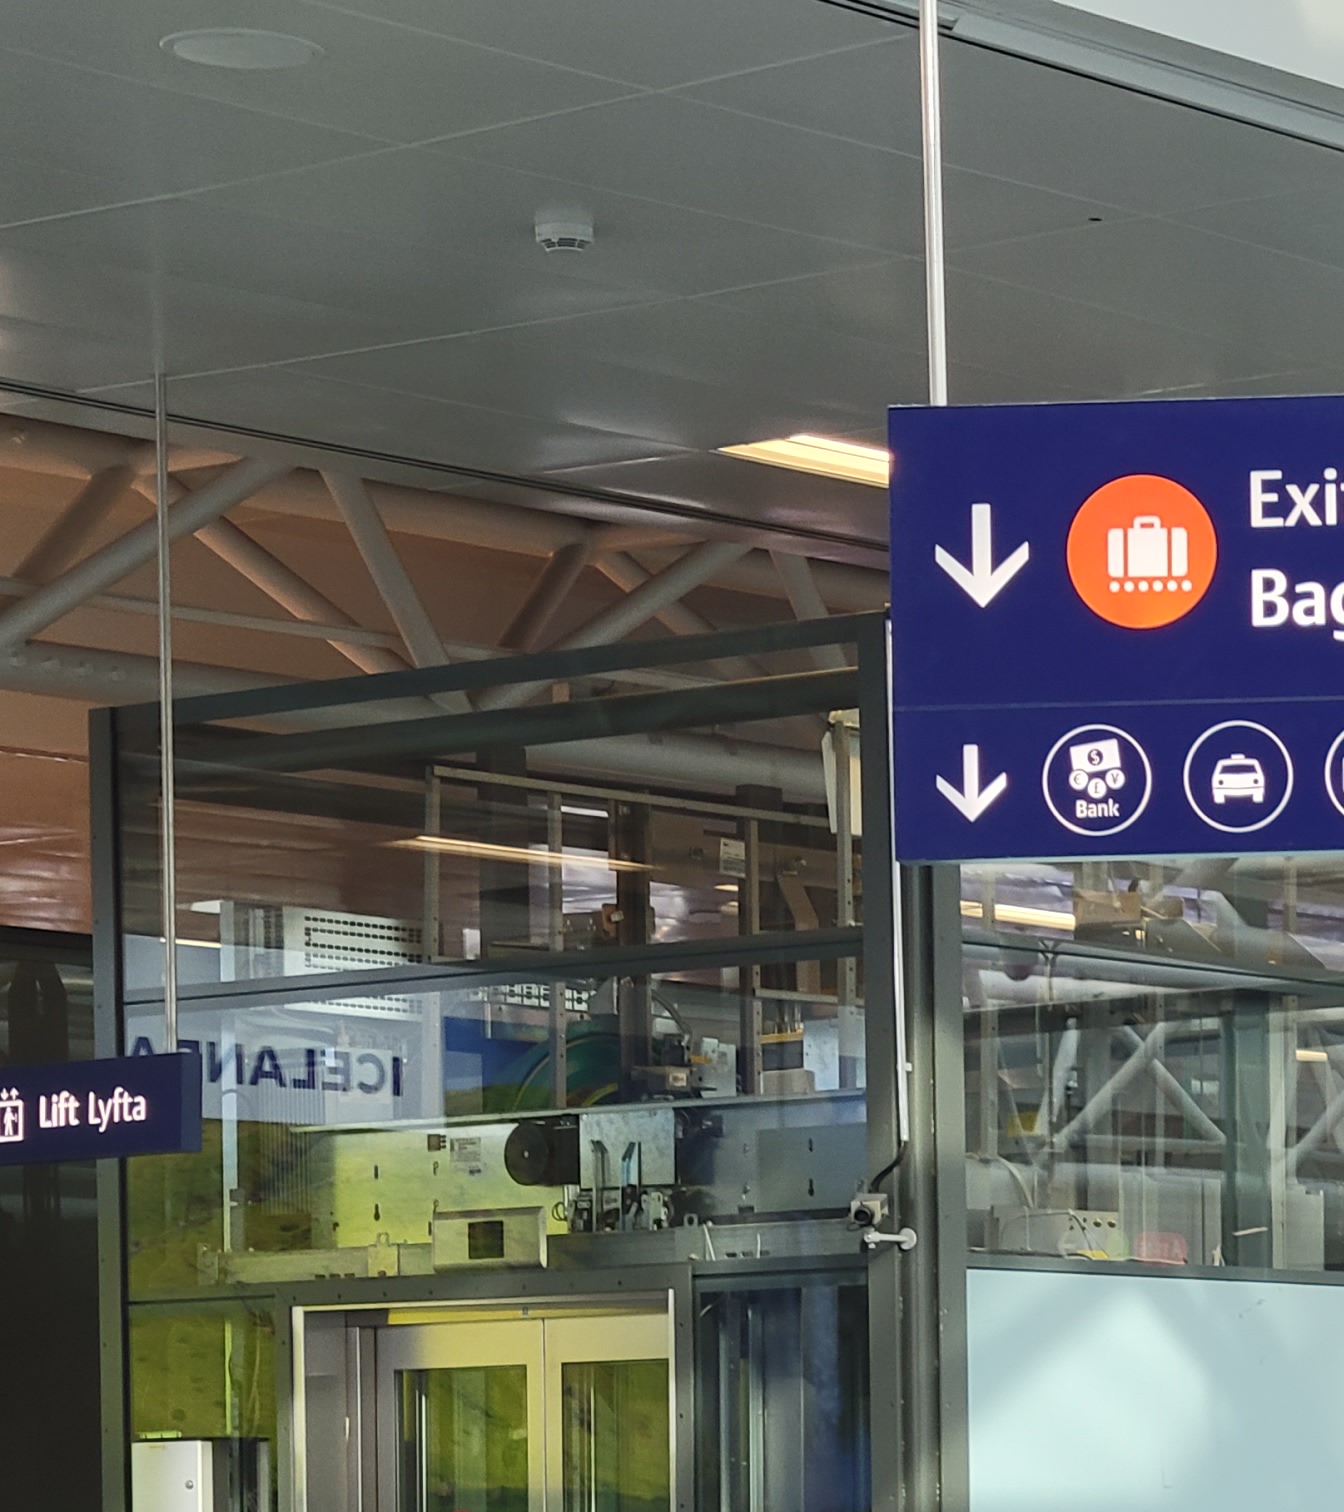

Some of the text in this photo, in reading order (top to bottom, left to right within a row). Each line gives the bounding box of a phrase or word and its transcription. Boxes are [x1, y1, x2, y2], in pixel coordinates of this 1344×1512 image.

[1076, 798, 1120, 818] Bank
[38, 1086, 147, 1133] Lift Lyfta
